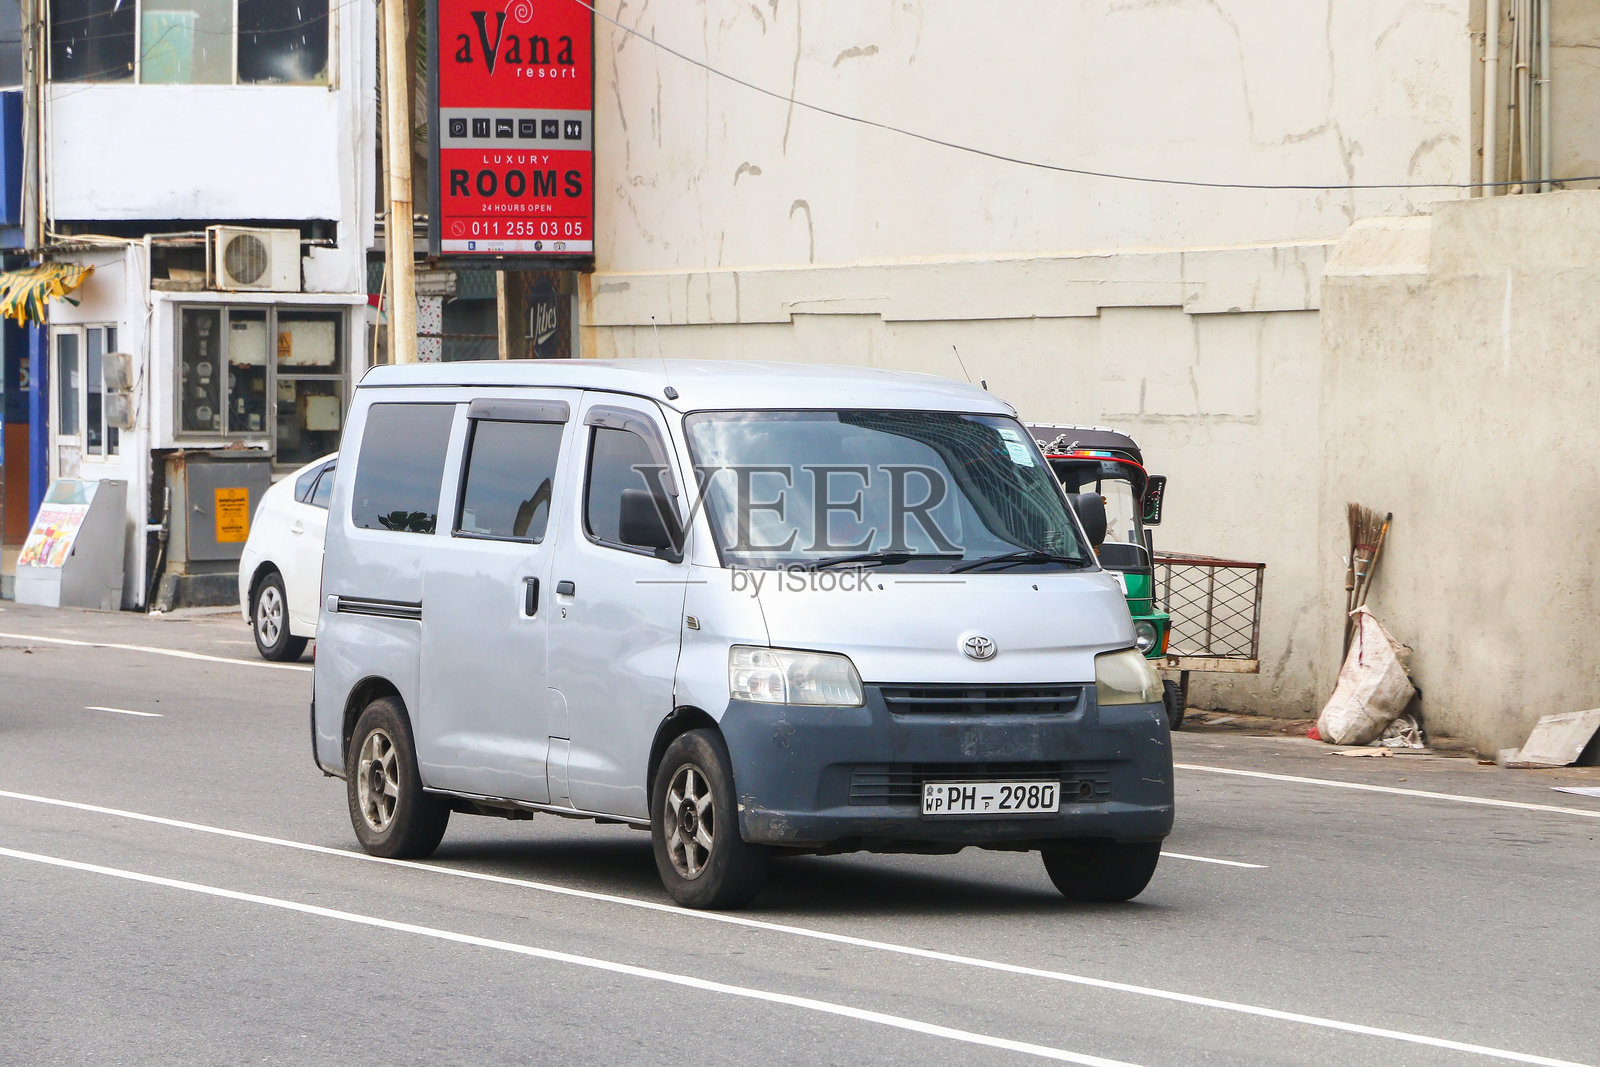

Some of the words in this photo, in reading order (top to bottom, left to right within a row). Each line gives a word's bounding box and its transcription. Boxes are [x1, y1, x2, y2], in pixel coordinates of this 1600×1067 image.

[455, 11, 574, 76] aVana
[516, 67, 576, 79] resort
[483, 155, 549, 164] LUXURY
[450, 169, 583, 198] ROOMS
[482, 204, 493, 212] 24
[495, 204, 525, 212] HOURS
[528, 204, 552, 213] OPEN
[472, 222, 499, 236] 011
[506, 222, 534, 236] 255
[540, 222, 558, 236] 03
[564, 222, 582, 236] 05
[926, 798, 943, 811] WP
